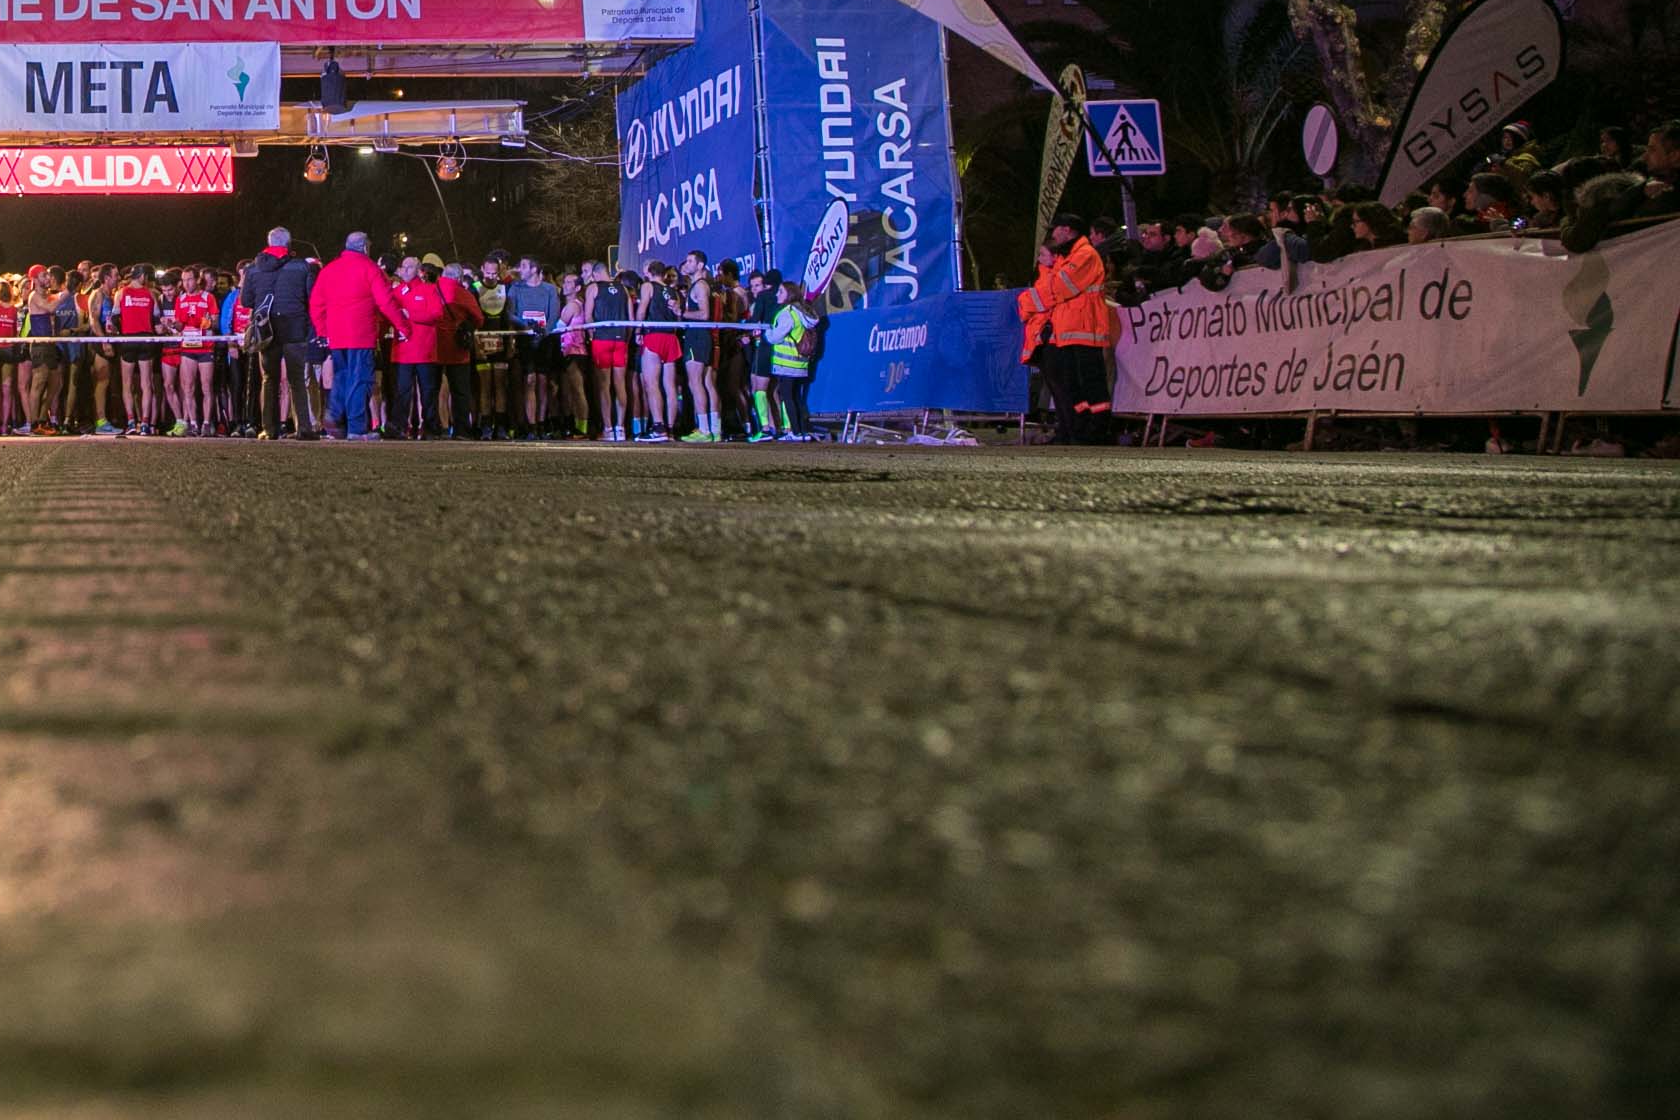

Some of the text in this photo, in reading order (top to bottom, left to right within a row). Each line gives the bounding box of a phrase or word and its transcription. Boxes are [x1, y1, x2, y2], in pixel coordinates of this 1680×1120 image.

[675, 6, 685, 14] de
[26, 61, 180, 114] META
[650, 65, 741, 160] HYUNDAI
[29, 155, 171, 187] SALIDA
[873, 77, 919, 300] JACARSA
[638, 167, 723, 254] JACARSA
[814, 217, 845, 280] POINT
[869, 323, 928, 353] Cruzcampo
[1128, 267, 1473, 344] Patronato Municipal de
[1145, 340, 1406, 409] Deportes de Jaén
